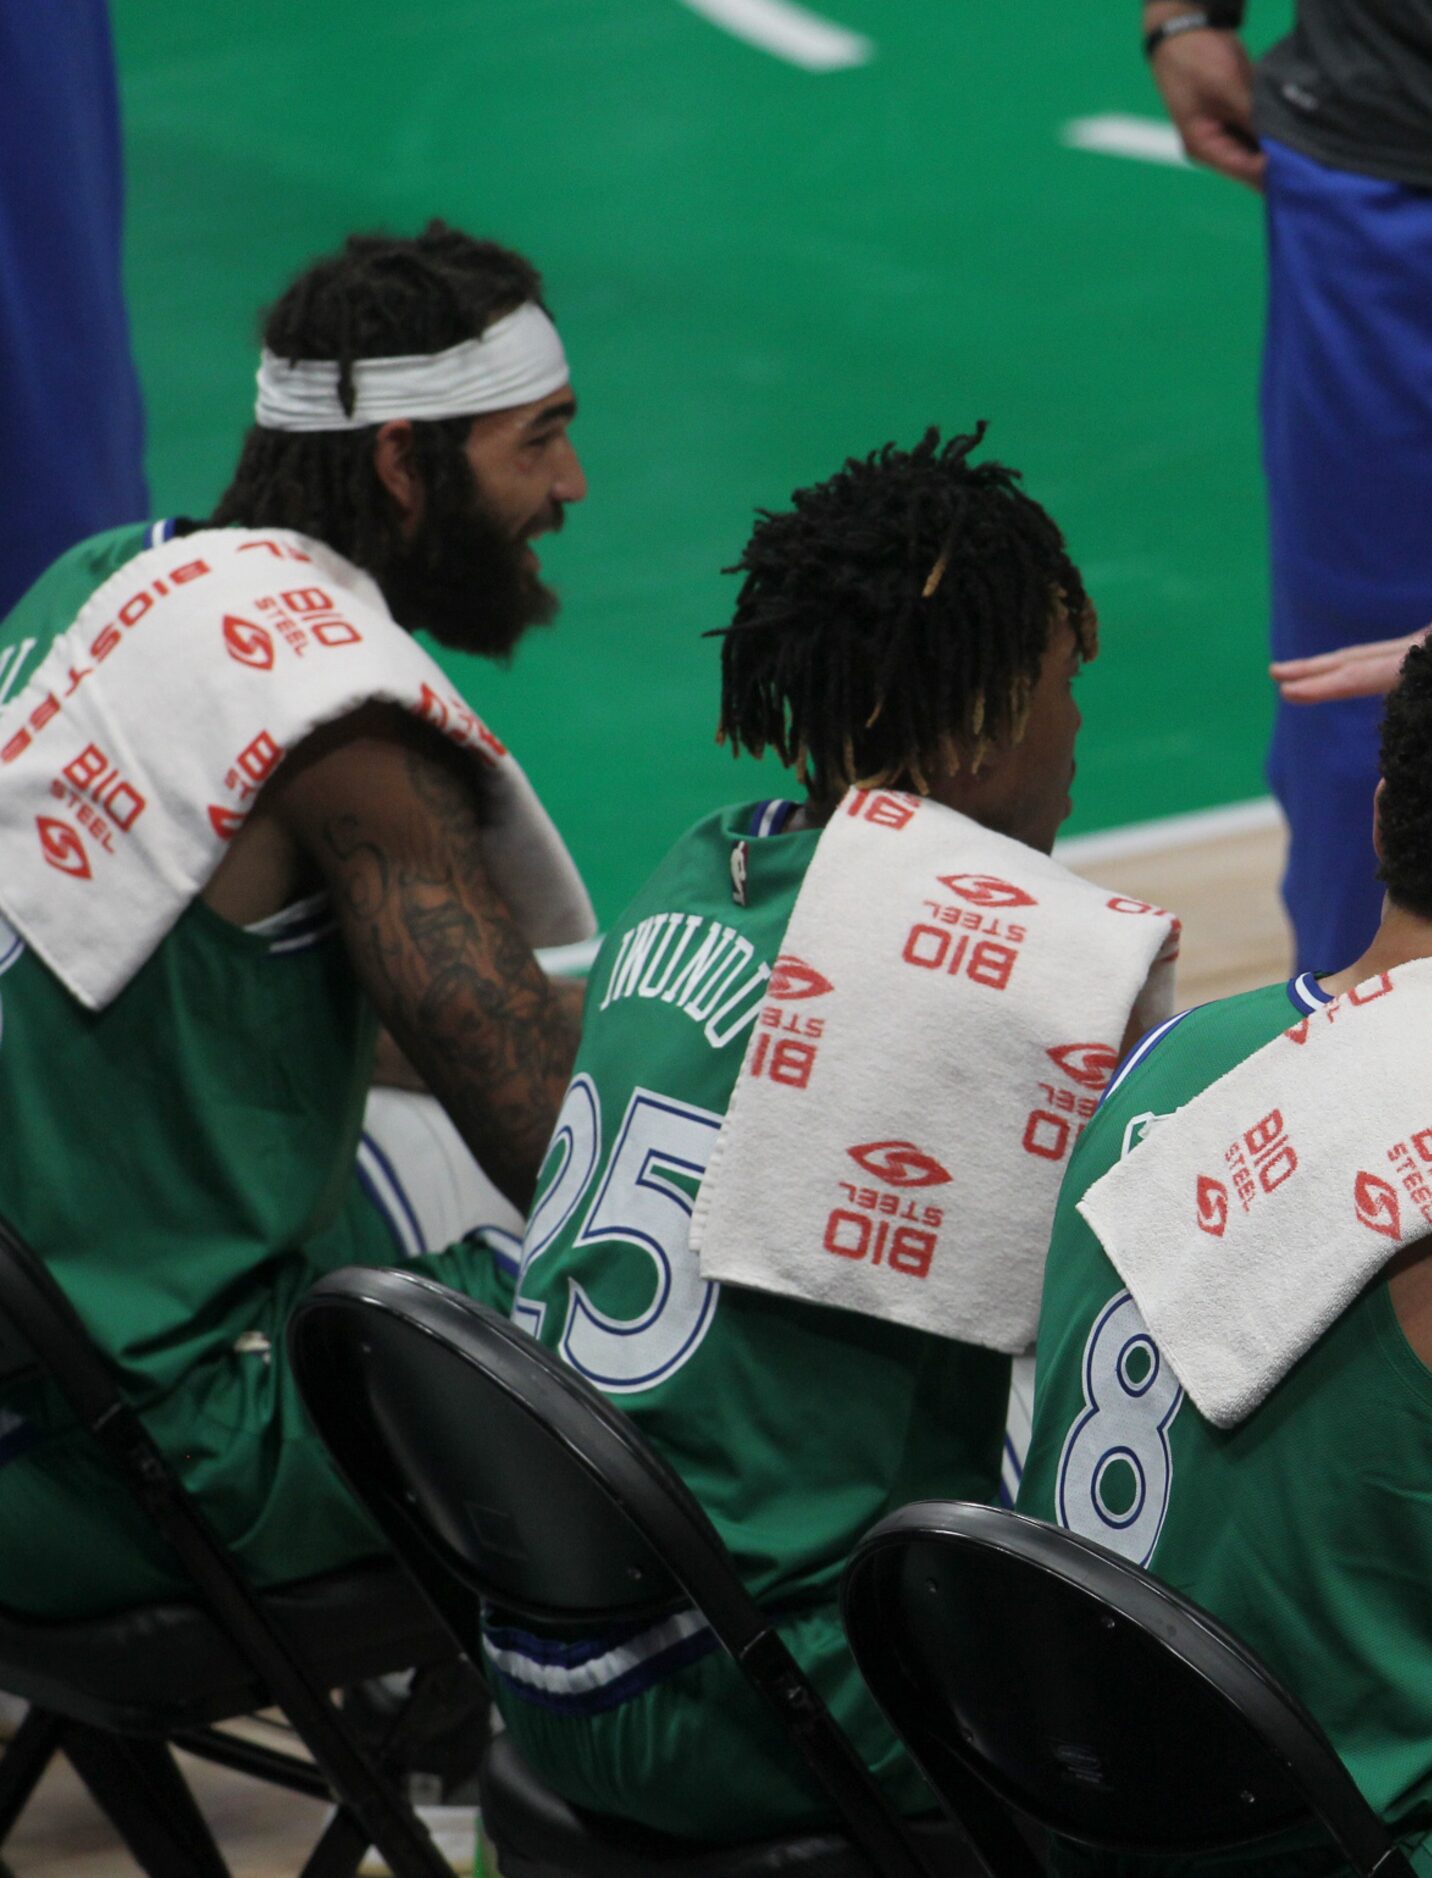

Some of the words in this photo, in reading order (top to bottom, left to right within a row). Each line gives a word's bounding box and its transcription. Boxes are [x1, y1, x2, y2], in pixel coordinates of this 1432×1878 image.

[254, 596, 309, 660] STEEL
[279, 586, 363, 647] BIO
[50, 777, 116, 855] STEEL
[62, 743, 147, 833] BIO
[846, 788, 914, 831] BI
[922, 900, 1029, 944] STEEL
[902, 923, 1019, 992] BIO
[760, 1006, 826, 1039] STE
[751, 1032, 818, 1090] BI
[1037, 1081, 1099, 1119] EEL
[1225, 1142, 1257, 1213] STEEL
[1243, 1108, 1298, 1194] BIO
[511, 1072, 726, 1394] 25
[838, 1181, 945, 1228] STEEL
[823, 1208, 938, 1280] BIO
[1055, 1286, 1184, 1571] 8
